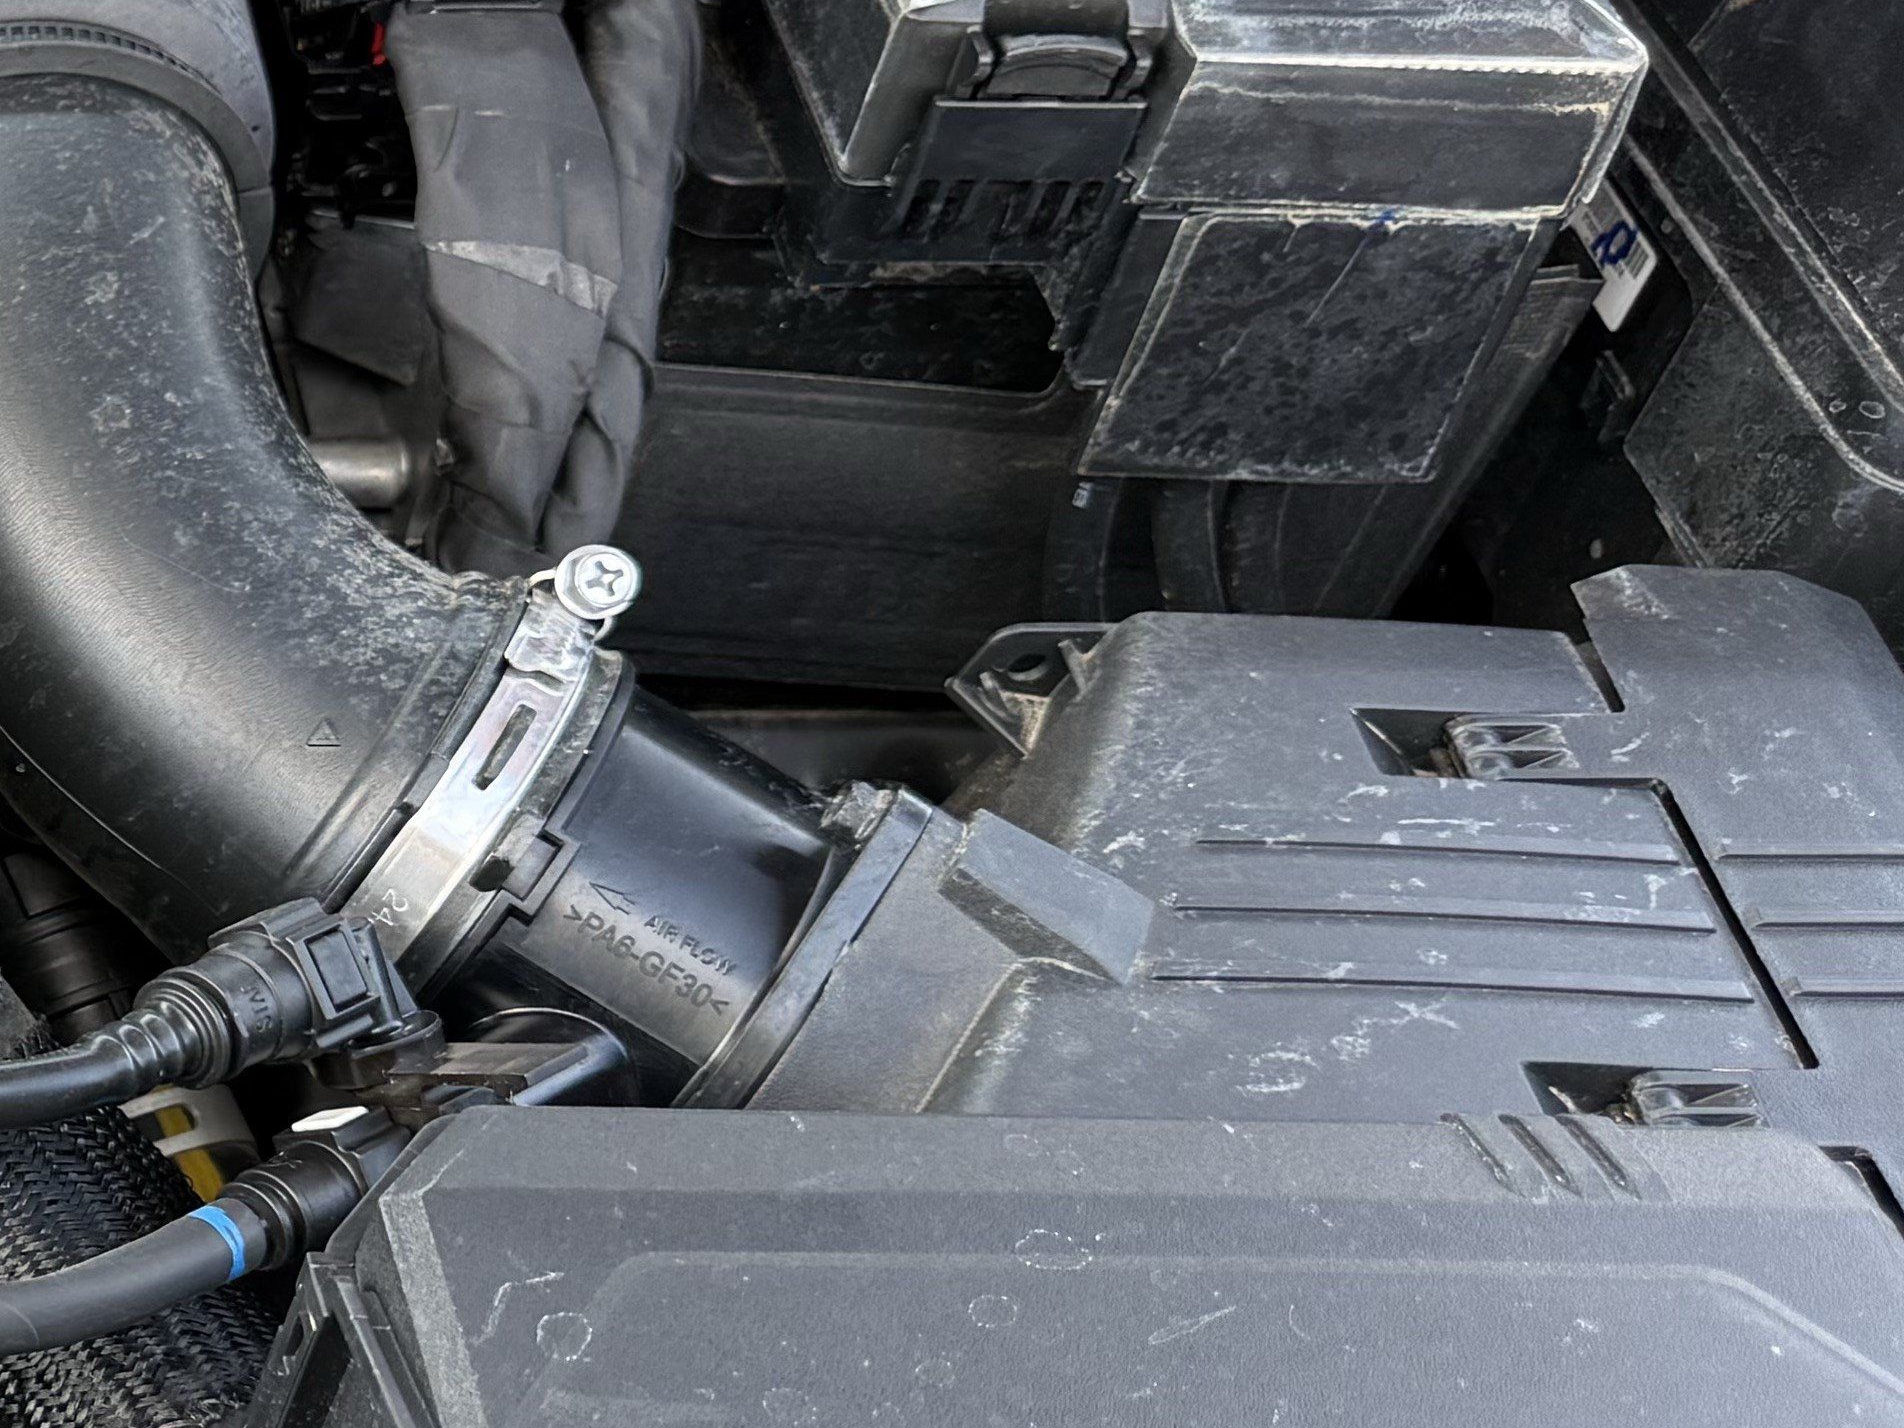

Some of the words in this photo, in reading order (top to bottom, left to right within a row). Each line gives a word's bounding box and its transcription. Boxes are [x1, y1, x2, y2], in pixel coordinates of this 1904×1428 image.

[563, 903, 731, 1016] >PA6-GF30<
[644, 915, 679, 944] AIR
[679, 933, 738, 976] FLOW
